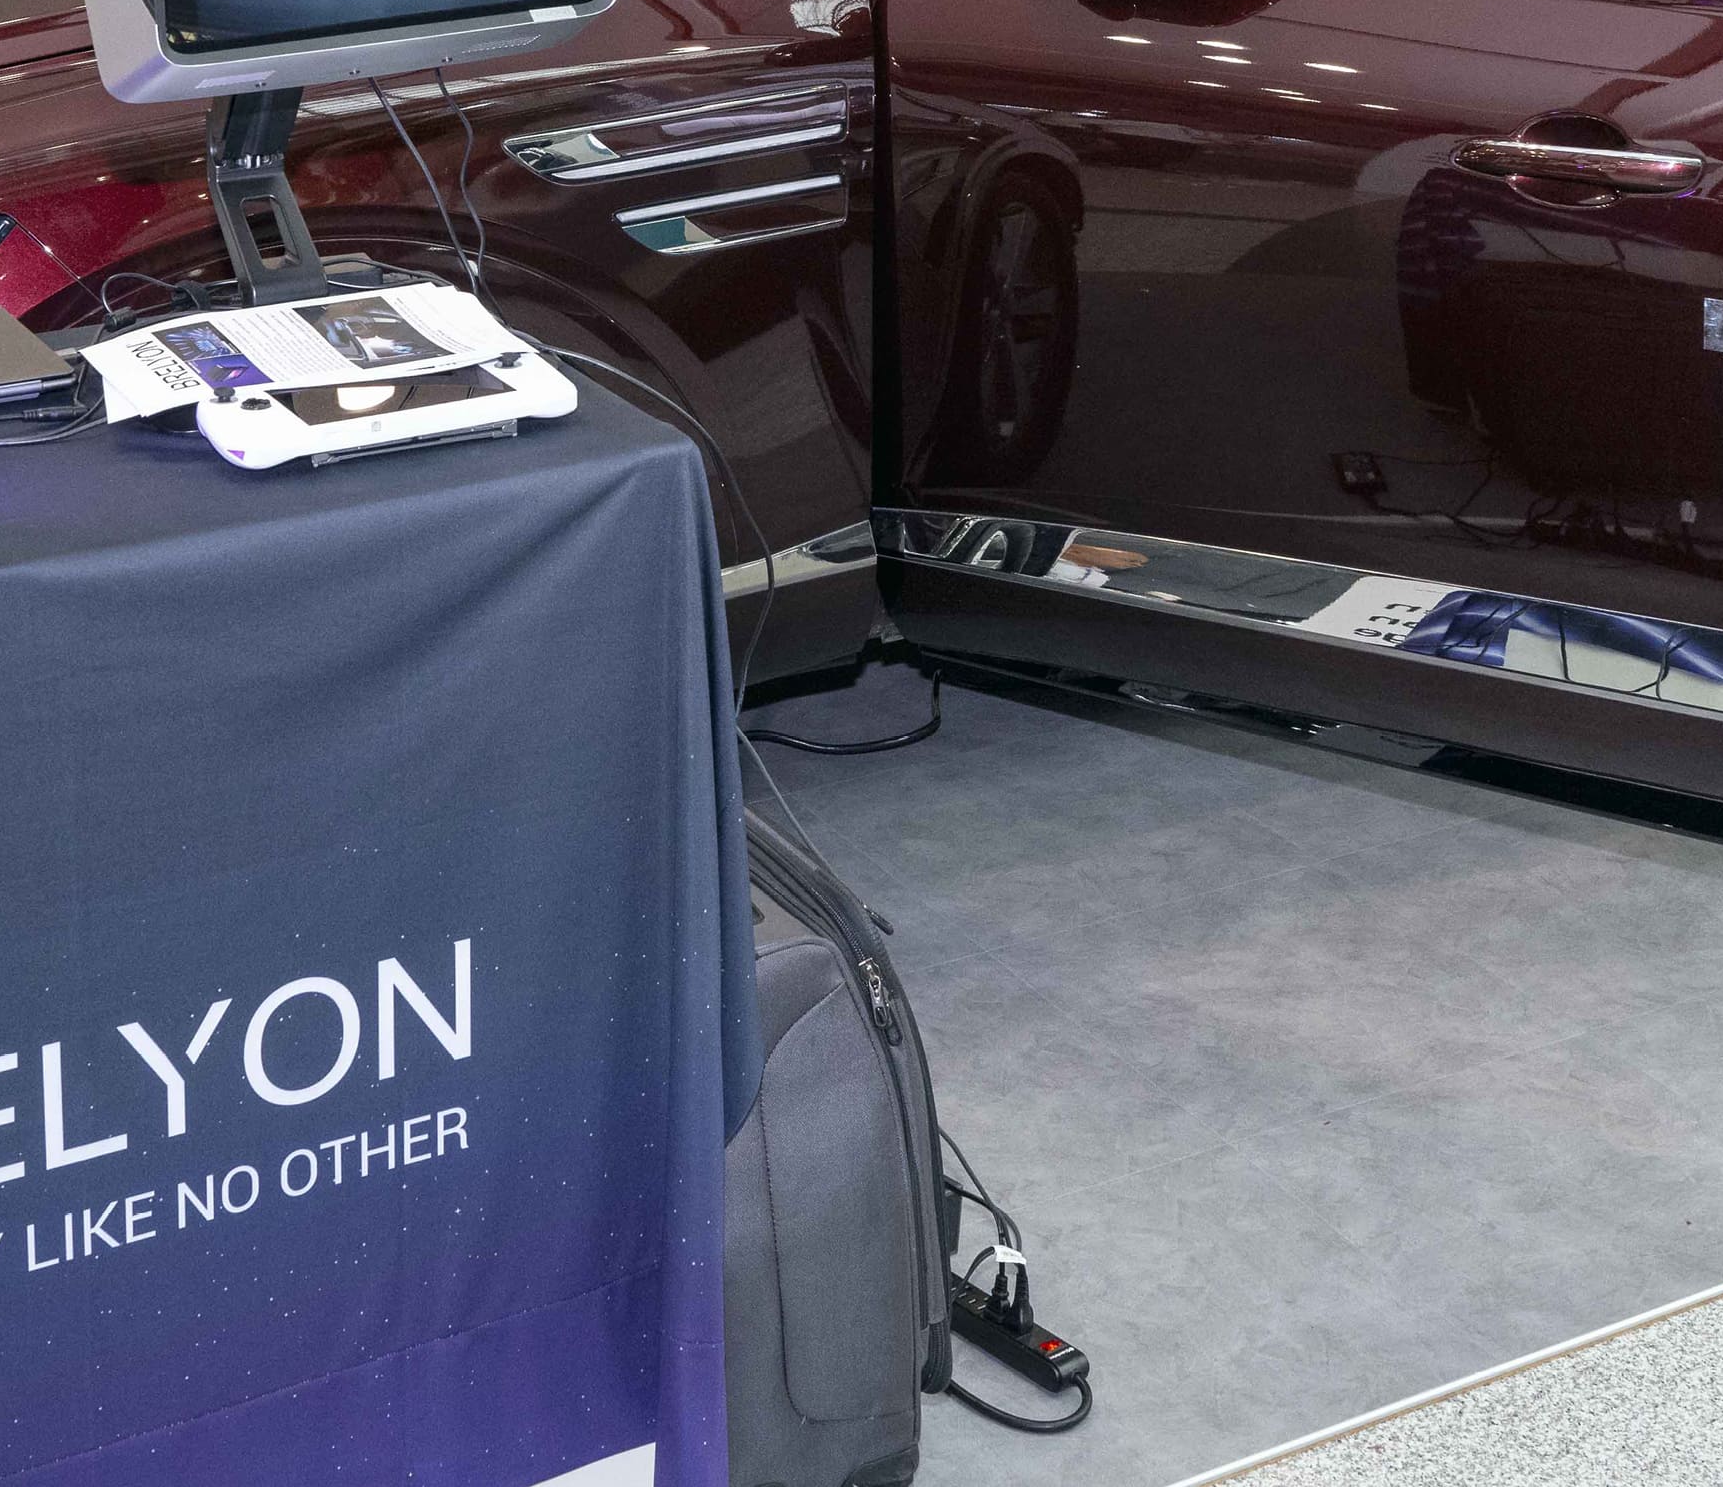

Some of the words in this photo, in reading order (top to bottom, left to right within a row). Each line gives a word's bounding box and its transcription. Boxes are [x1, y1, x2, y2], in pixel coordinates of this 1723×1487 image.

[126, 340, 201, 391] BRELYON
[26, 1191, 157, 1272] LIKE
[177, 1164, 260, 1230] NO
[280, 1106, 469, 1198] OTHER
